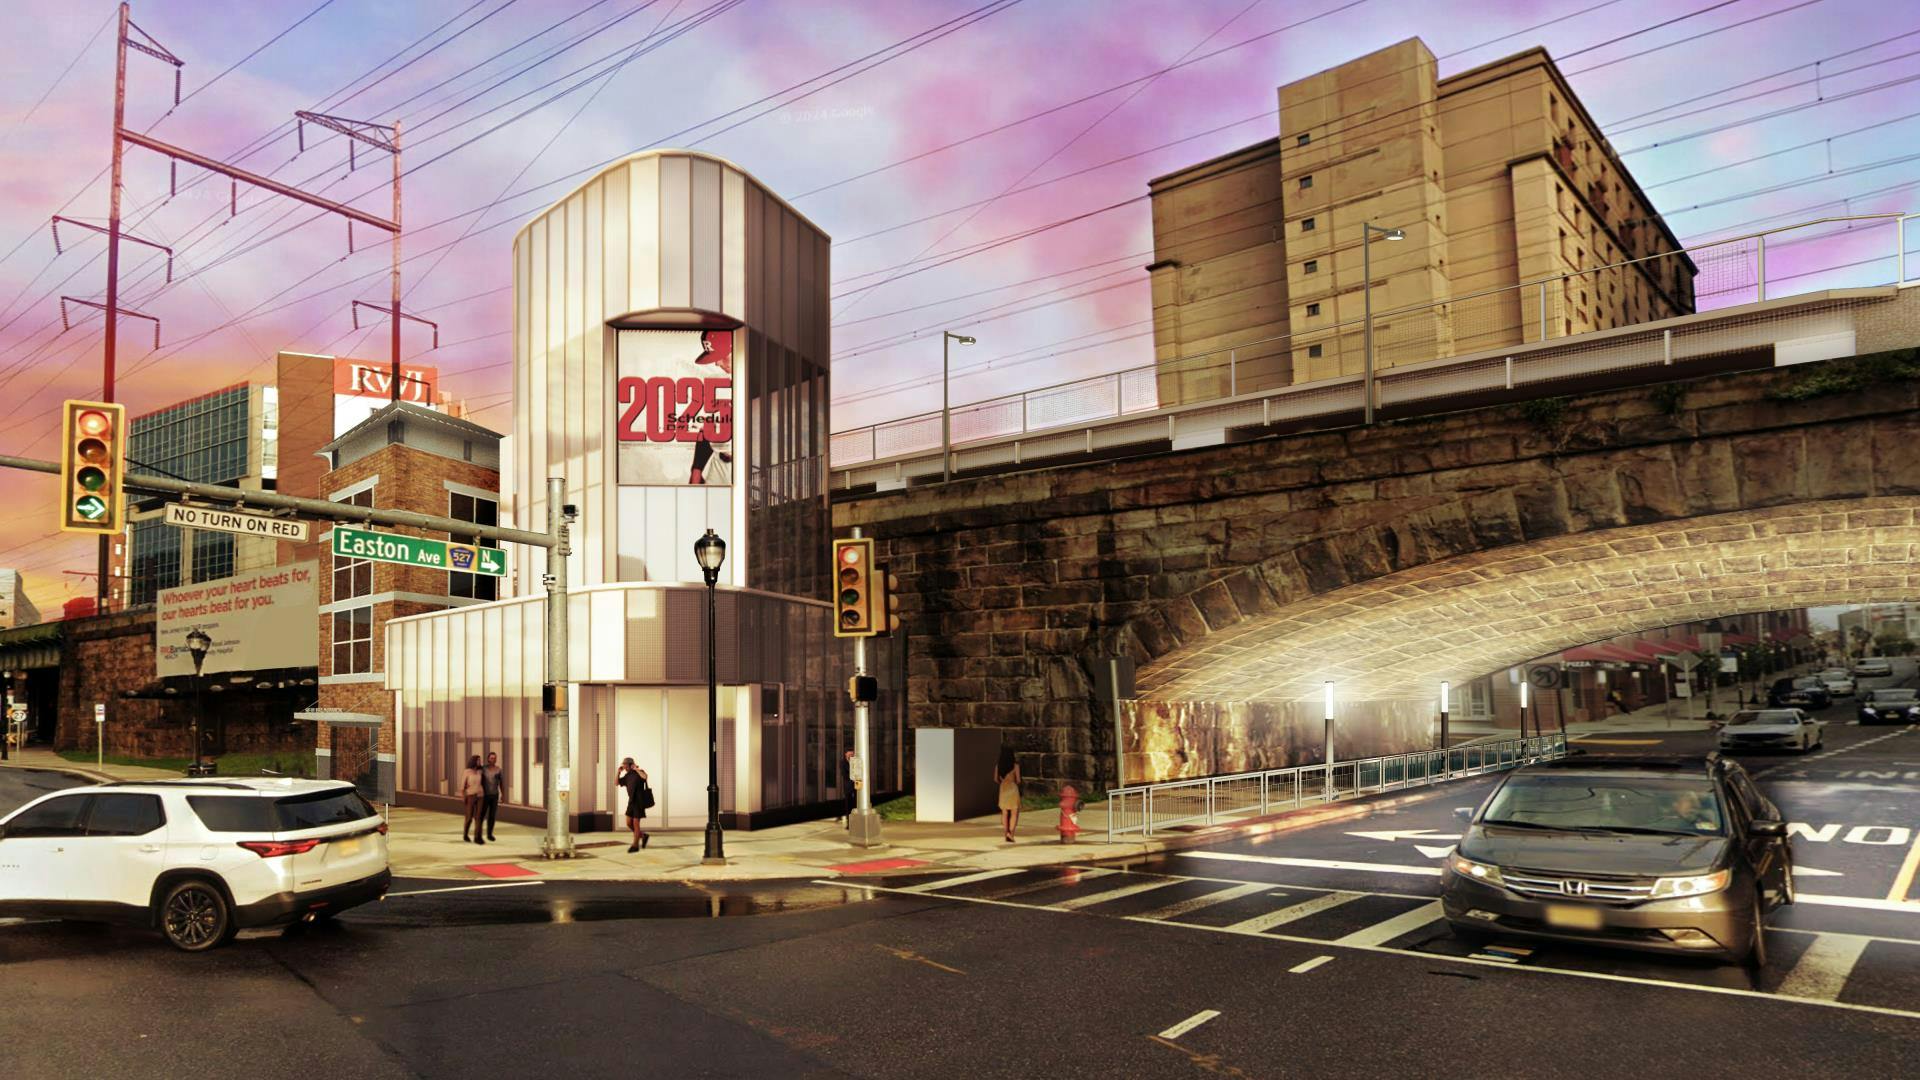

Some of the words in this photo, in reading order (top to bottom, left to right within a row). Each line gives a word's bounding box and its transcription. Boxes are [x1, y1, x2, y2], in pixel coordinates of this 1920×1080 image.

[618, 376, 733, 443] 2025
[174, 508, 196, 522] NO
[201, 512, 242, 529] TURN
[247, 519, 267, 532] ON
[272, 522, 300, 537] RED
[340, 531, 409, 560] Easton
[418, 549, 441, 564] Ave
[453, 552, 470, 562] 527
[482, 550, 491, 562] N
[162, 590, 205, 605] Whoever
[206, 584, 229, 599] your
[230, 578, 257, 594] heart
[259, 572, 289, 589] beats
[292, 568, 311, 583] for,
[161, 609, 177, 621] our
[179, 604, 209, 618] hearts
[209, 600, 233, 614] beat
[234, 597, 249, 610] for
[251, 594, 275, 610] you.
[14, 712, 24, 720] 27
[1787, 822, 1911, 845] NO
